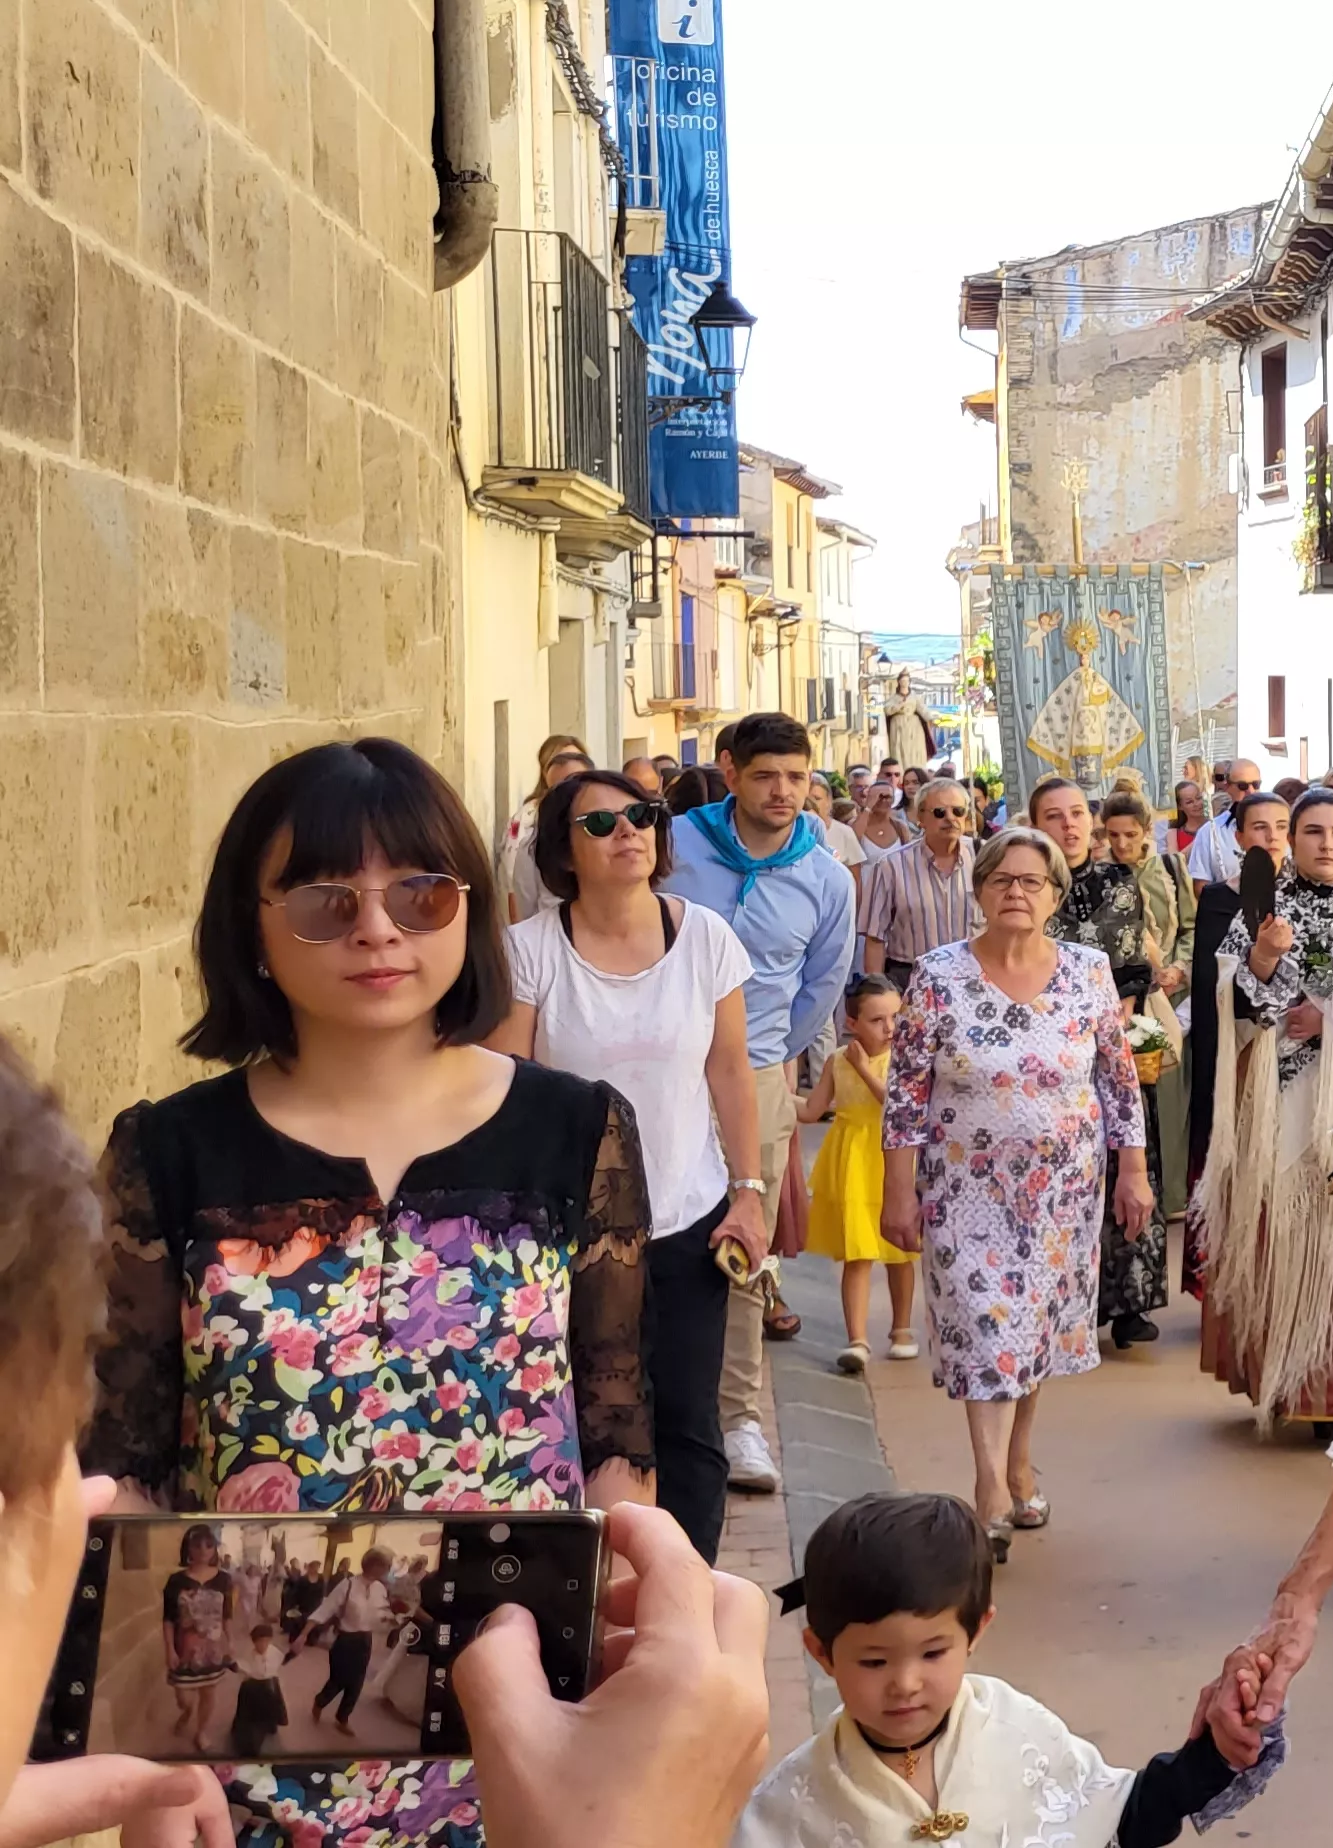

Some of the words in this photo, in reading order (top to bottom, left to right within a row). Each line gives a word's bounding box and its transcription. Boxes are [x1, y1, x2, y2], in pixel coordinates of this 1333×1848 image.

[637, 61, 716, 83] oficina
[687, 87, 716, 107] de
[703, 150, 719, 214] huesca
[704, 219, 721, 241] de
[690, 449, 728, 459] AYERBE
